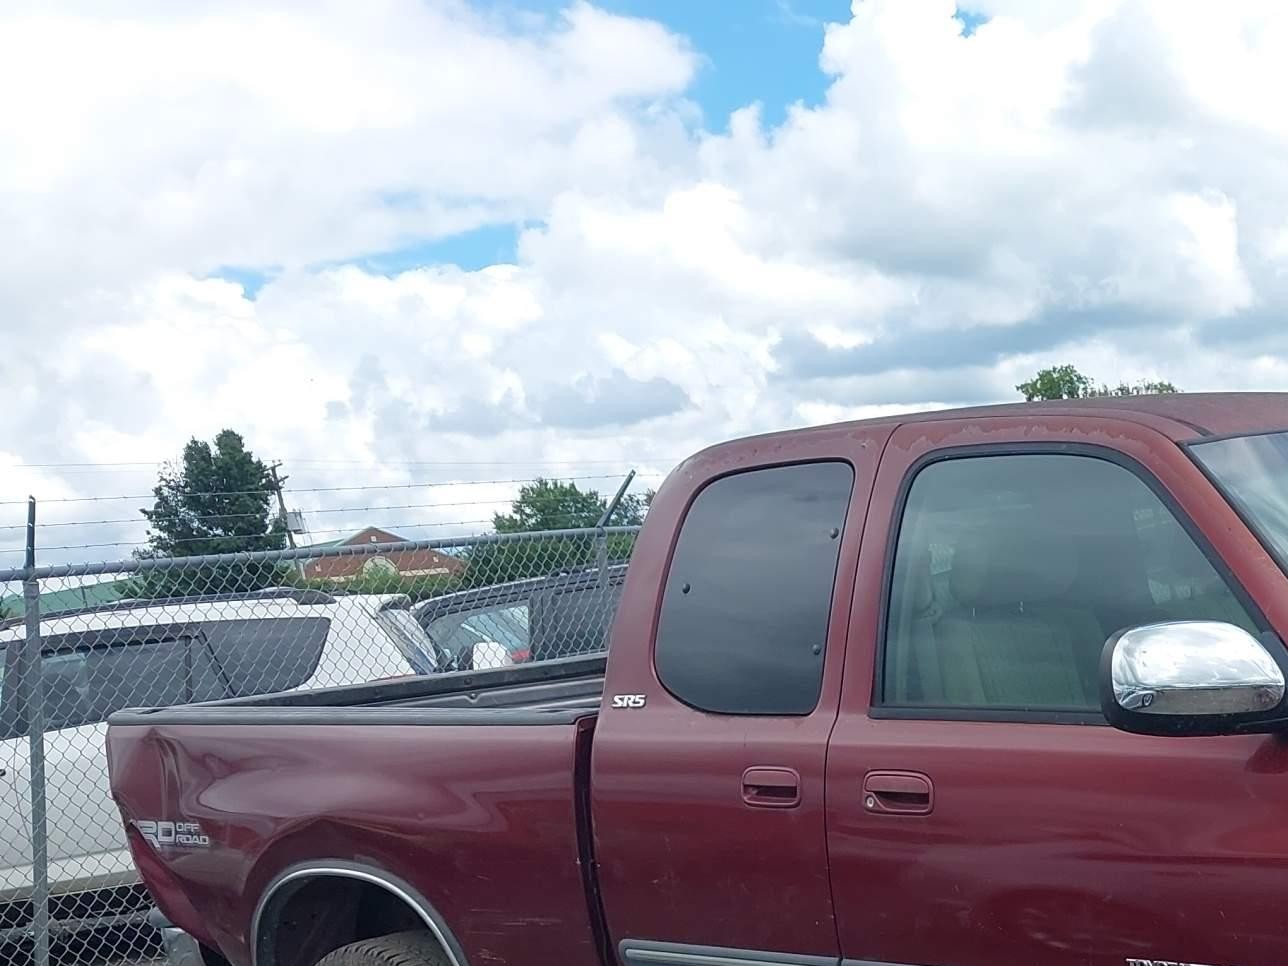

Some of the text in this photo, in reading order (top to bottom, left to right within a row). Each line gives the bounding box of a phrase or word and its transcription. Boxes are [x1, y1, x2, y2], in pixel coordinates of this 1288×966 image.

[611, 694, 646, 708] SR5
[175, 822, 200, 833] OFF
[175, 834, 210, 846] ROAD
